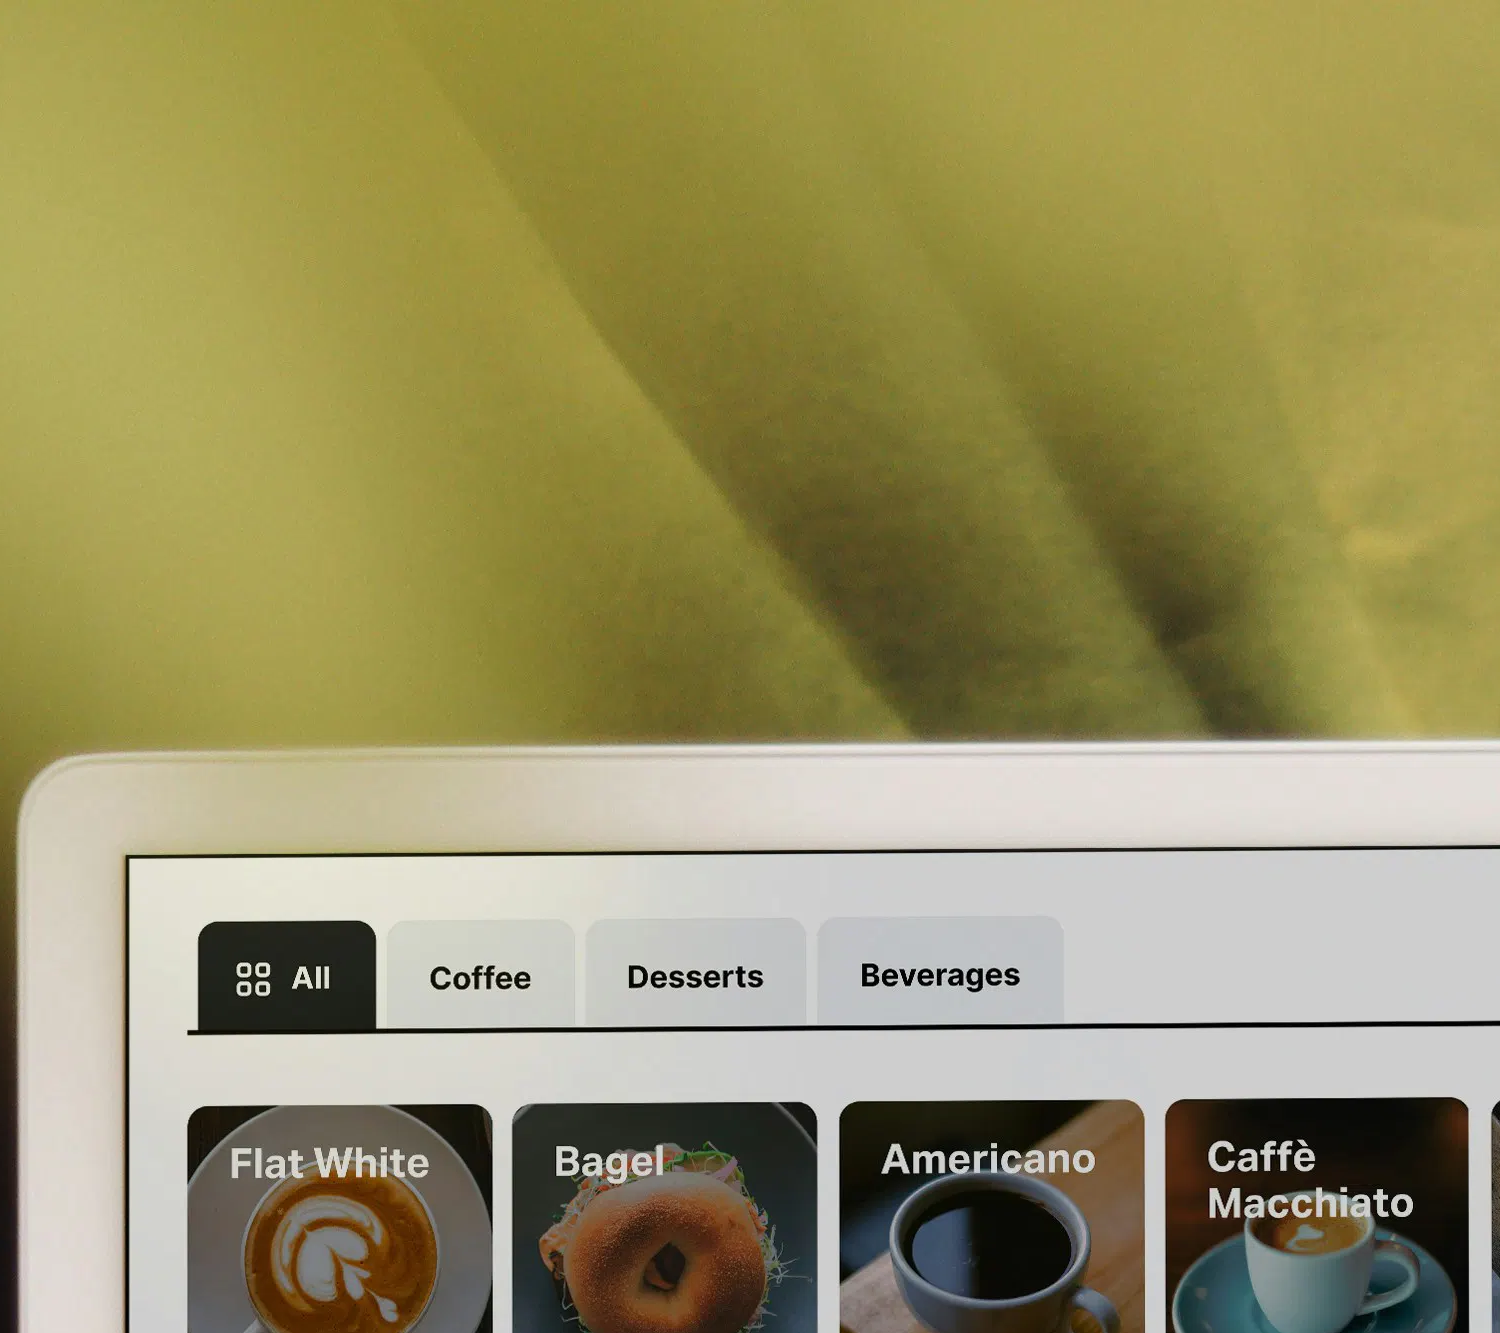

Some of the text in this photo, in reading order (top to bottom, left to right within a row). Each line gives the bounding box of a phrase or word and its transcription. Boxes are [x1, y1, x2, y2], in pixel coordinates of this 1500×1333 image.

[291, 965, 331, 990] All
[429, 965, 532, 991] Coffee
[627, 963, 764, 990] Desserts
[860, 962, 1021, 992] Beverages
[230, 1146, 430, 1179] Flat White
[555, 1145, 665, 1183] Bagel
[881, 1142, 1096, 1175] Americano
[1207, 1139, 1316, 1173] Caffè
[1207, 1186, 1414, 1219] Macchiato
